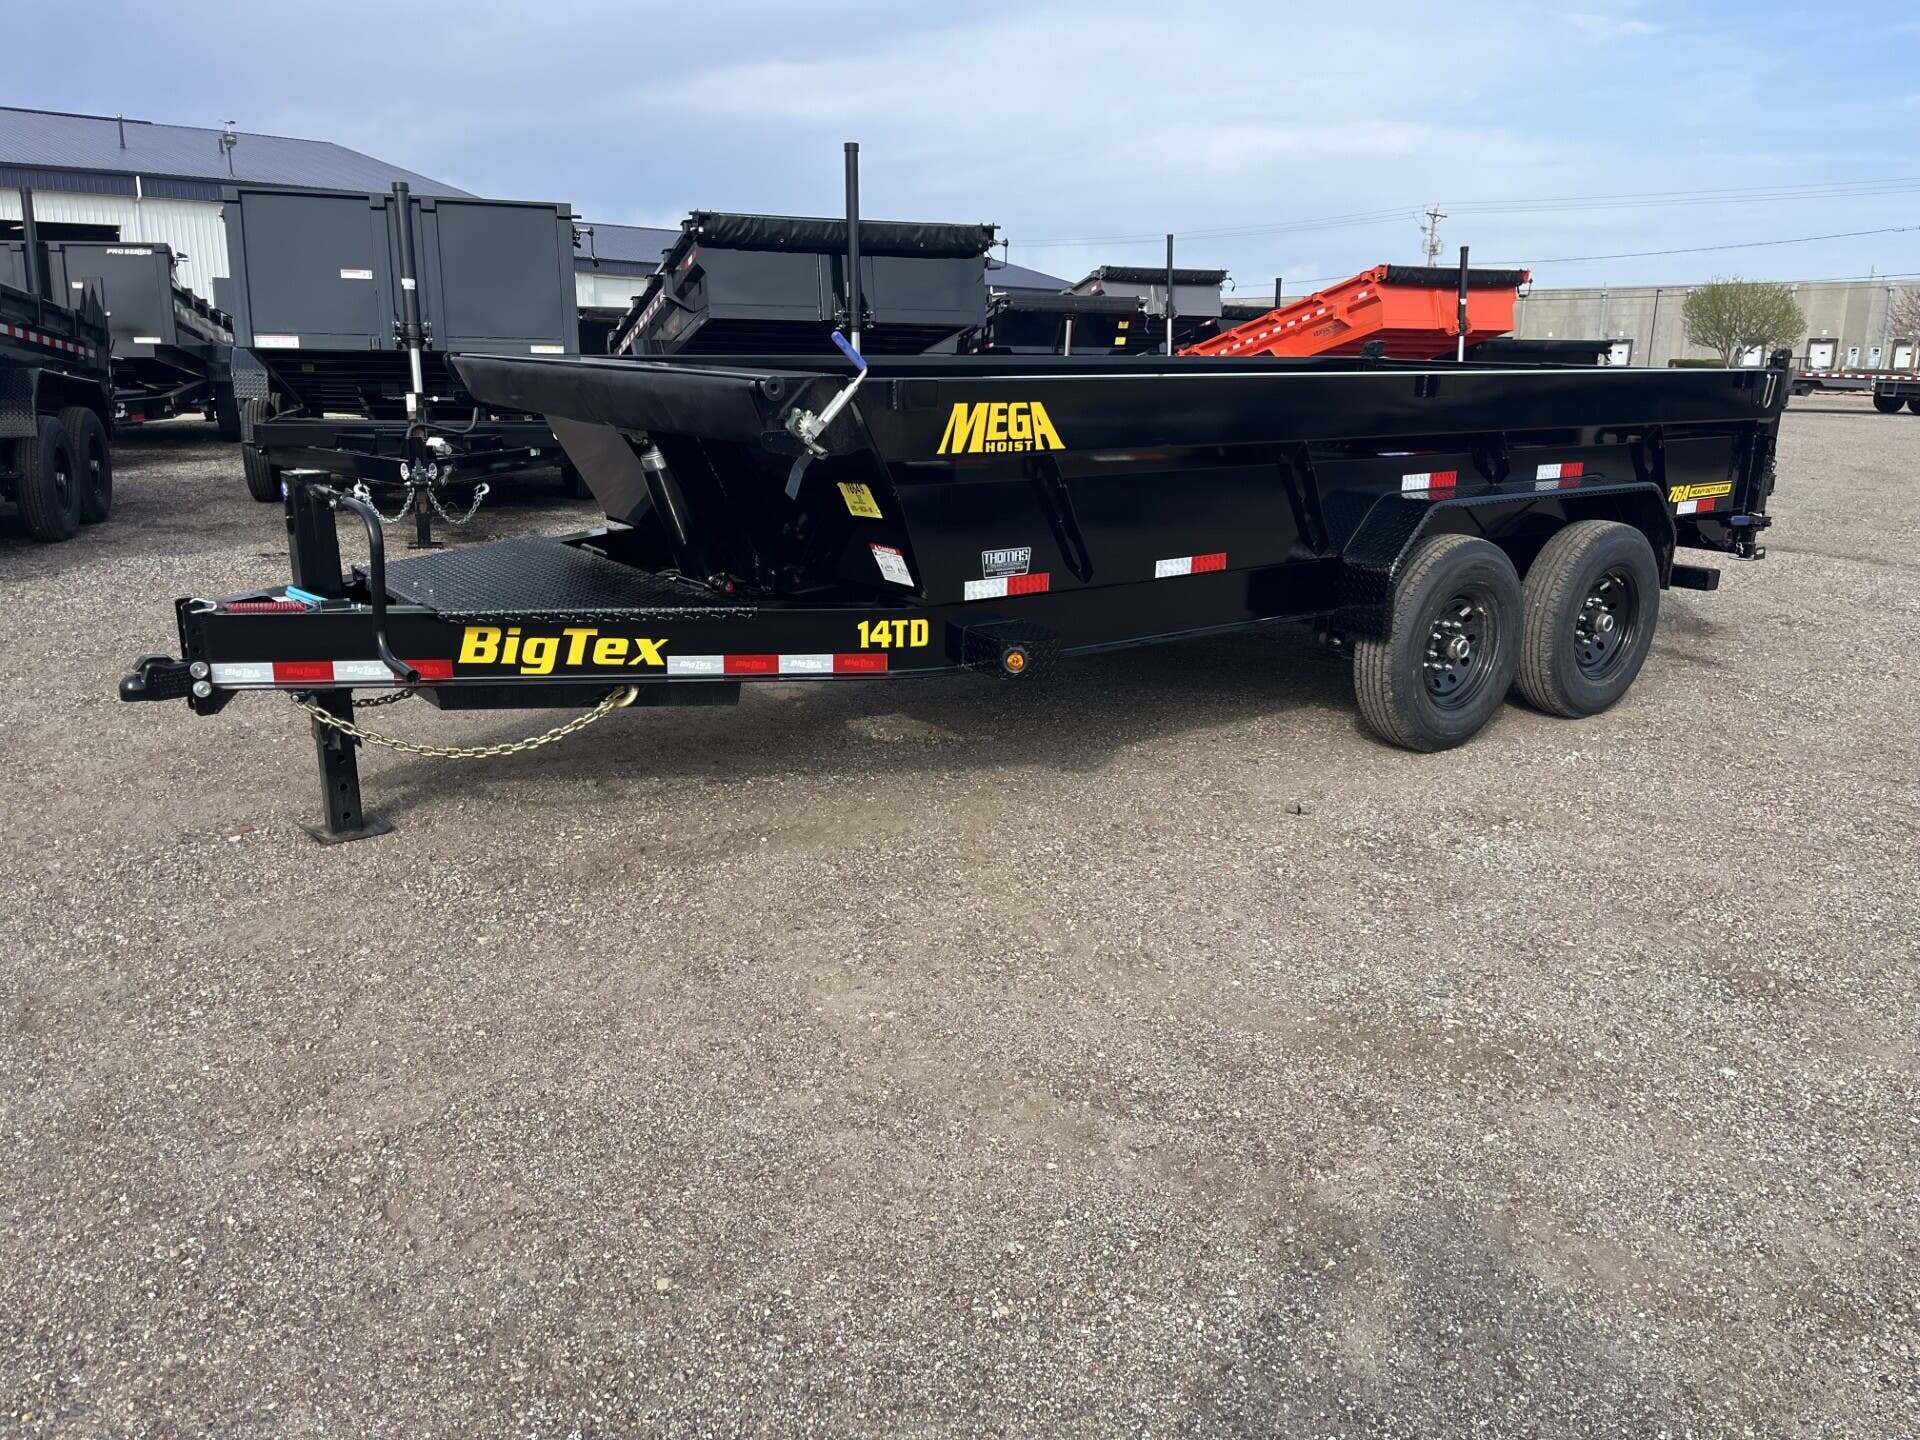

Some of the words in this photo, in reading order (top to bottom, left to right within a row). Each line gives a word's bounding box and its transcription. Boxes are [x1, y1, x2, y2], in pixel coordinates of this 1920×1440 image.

[937, 402, 1066, 454] MEGA
[985, 441, 1033, 453] HOIST
[1668, 485, 1691, 502] 7GA
[984, 549, 1028, 564] THOMAS
[857, 619, 929, 648] 14TD
[458, 627, 669, 675] BigTex
[224, 668, 261, 678] BigTex
[346, 665, 382, 675] BigTex
